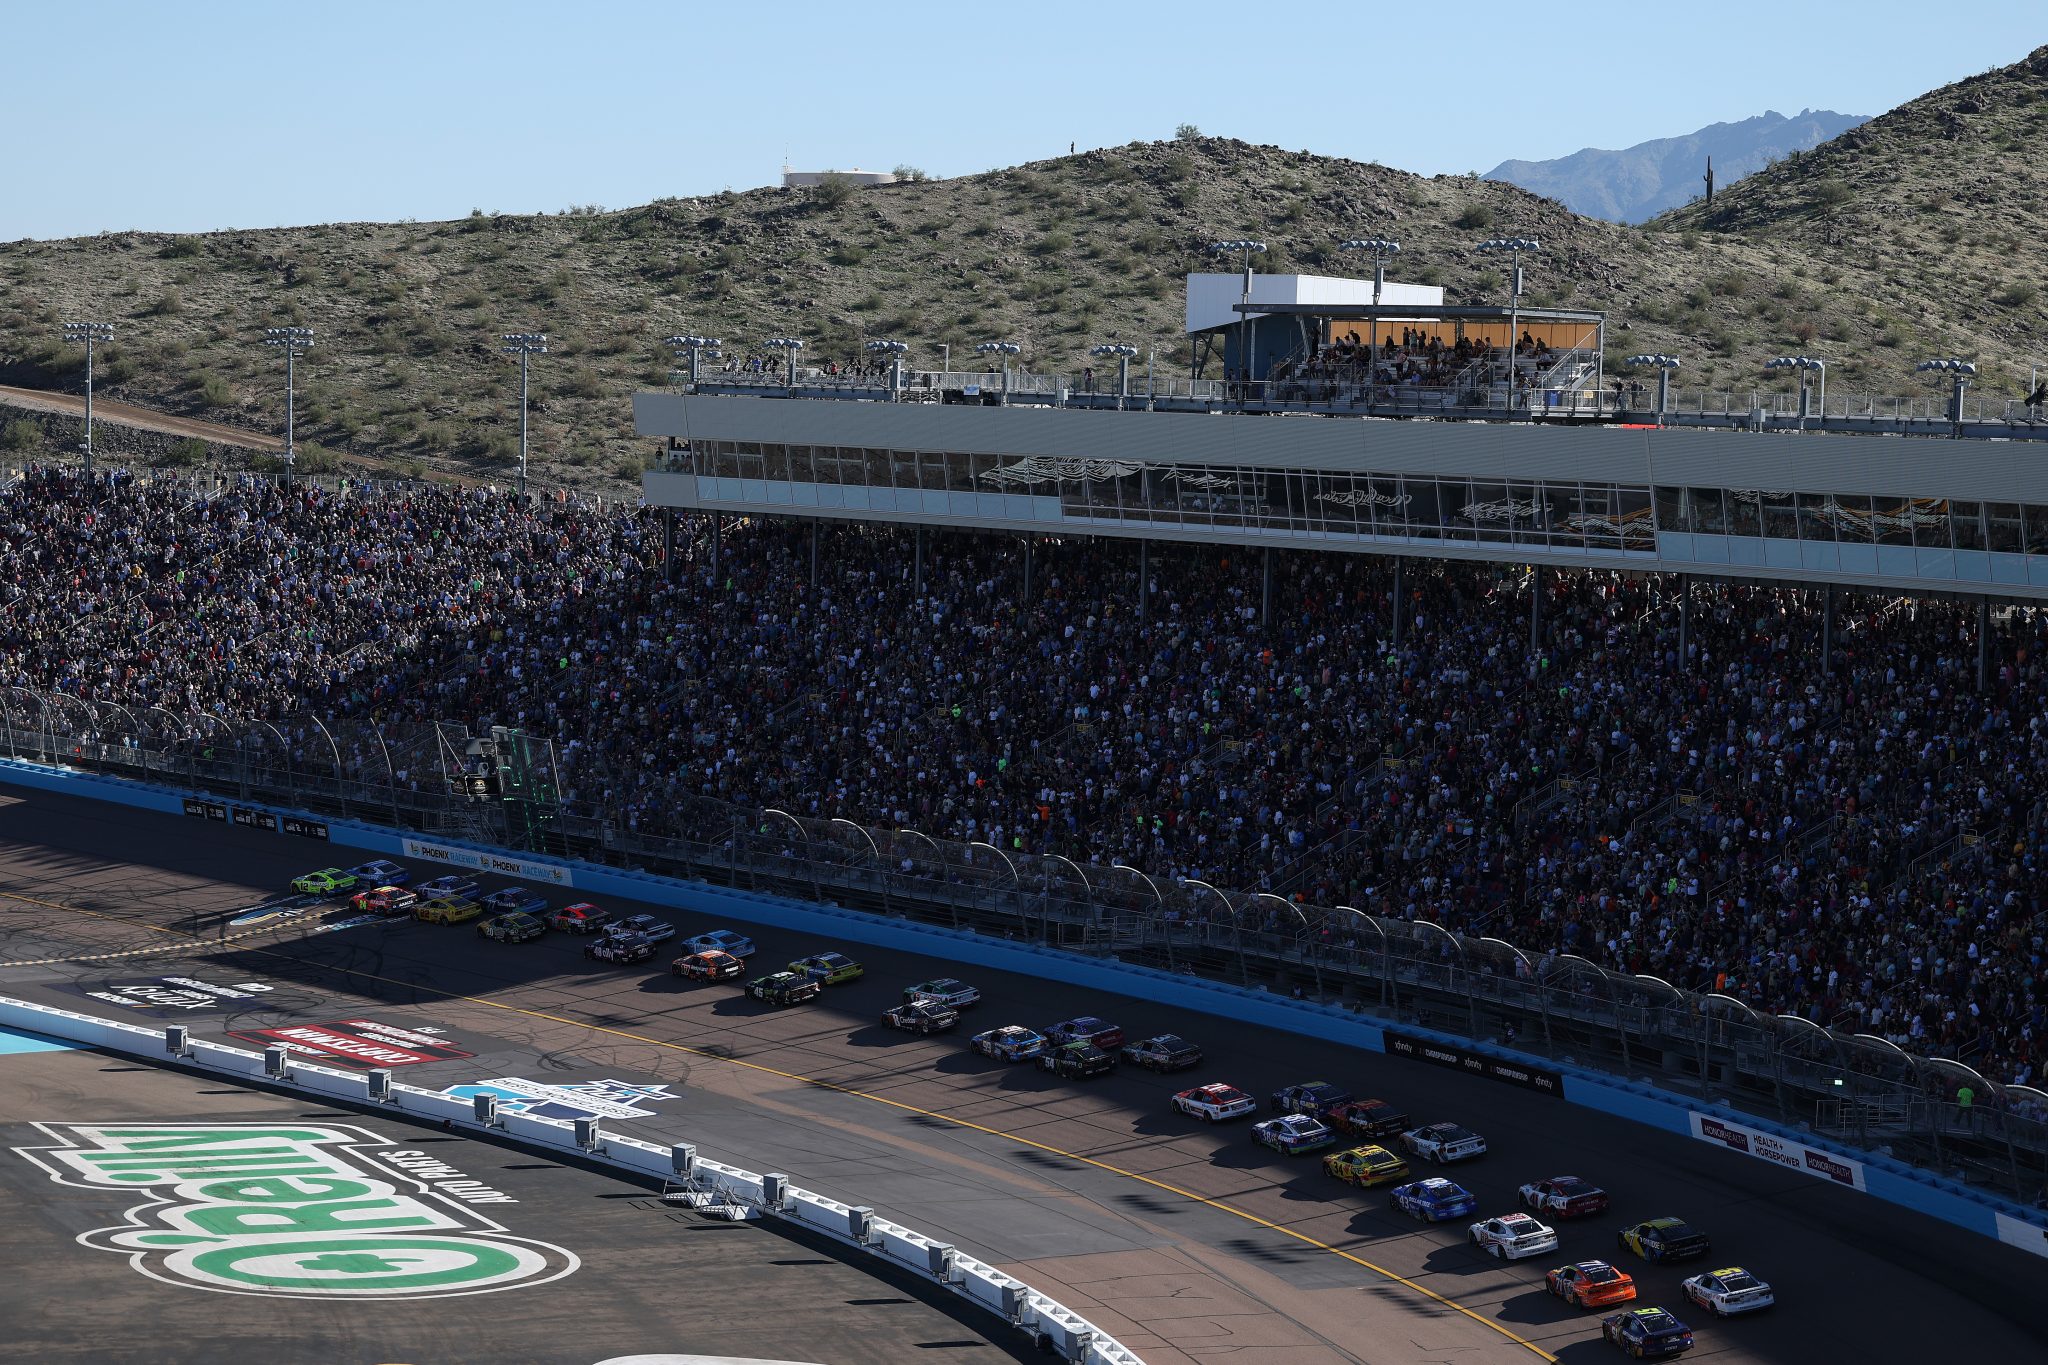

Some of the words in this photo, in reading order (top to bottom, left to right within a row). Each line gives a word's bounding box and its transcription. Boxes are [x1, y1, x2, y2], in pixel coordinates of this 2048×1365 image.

[422, 846, 449, 860] PHOENIX
[450, 852, 478, 865] RACEWAY
[492, 860, 520, 873] PHOENIX
[522, 864, 551, 877] RACEWAY
[300, 882, 309, 892] 12
[420, 908, 430, 918] 22
[486, 927, 494, 937] 20
[754, 986, 764, 998] 45
[892, 1014, 900, 1026] 8
[274, 1028, 422, 1063] CRAFTSMAN
[1045, 1056, 1054, 1068] 54
[1394, 1041, 1413, 1054] xfinity
[1464, 1057, 1482, 1071] xfinity
[1534, 1076, 1552, 1090] xfinity
[1262, 1130, 1272, 1142] 38
[1704, 1124, 1746, 1145] HONORHEALTH
[1753, 1134, 1778, 1150] HEALTH
[377, 1150, 462, 1180] PARTS
[1755, 1146, 1800, 1168] HORSEPOWER
[1333, 1161, 1344, 1176] 34
[1808, 1156, 1850, 1178] HONORHEALTH
[433, 1179, 520, 1204] AUTO
[1400, 1197, 1410, 1210] 43
